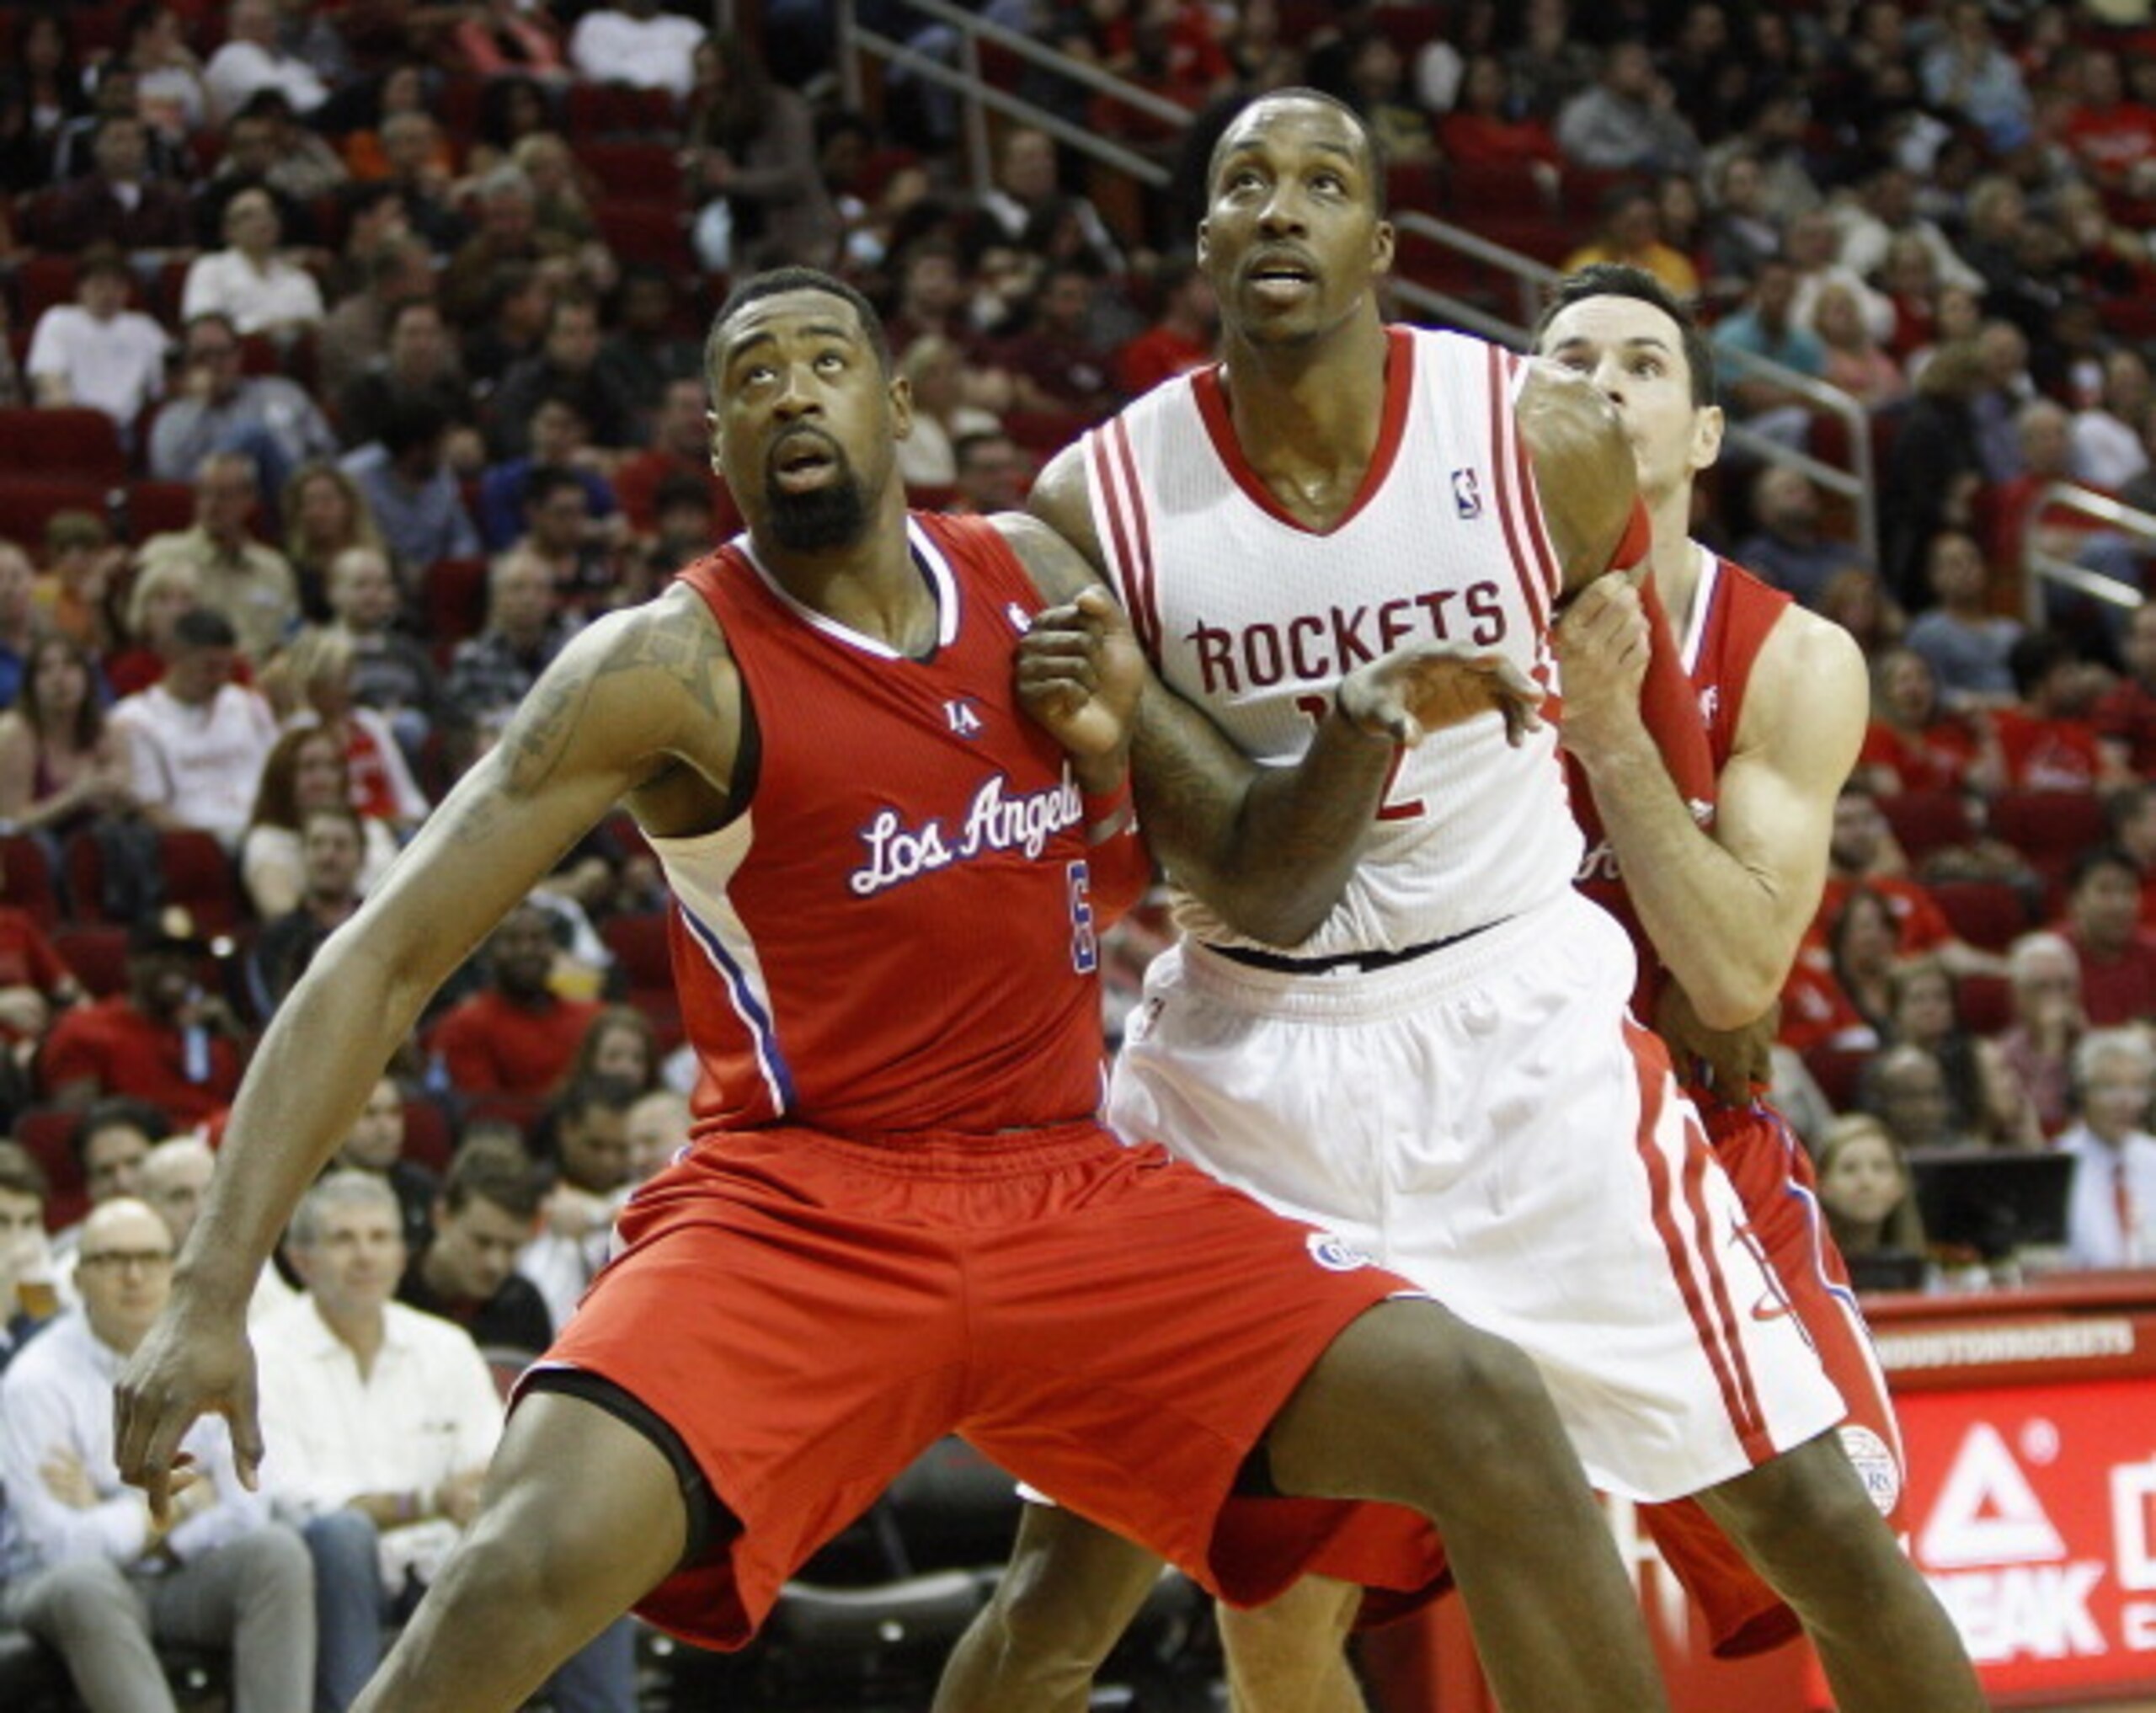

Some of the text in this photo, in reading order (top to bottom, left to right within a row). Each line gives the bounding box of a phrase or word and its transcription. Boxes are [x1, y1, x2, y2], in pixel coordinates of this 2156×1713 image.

[1186, 581, 1507, 693] ROCKETS
[851, 812, 952, 894] Los
[1924, 1561, 2107, 1662] EAK
